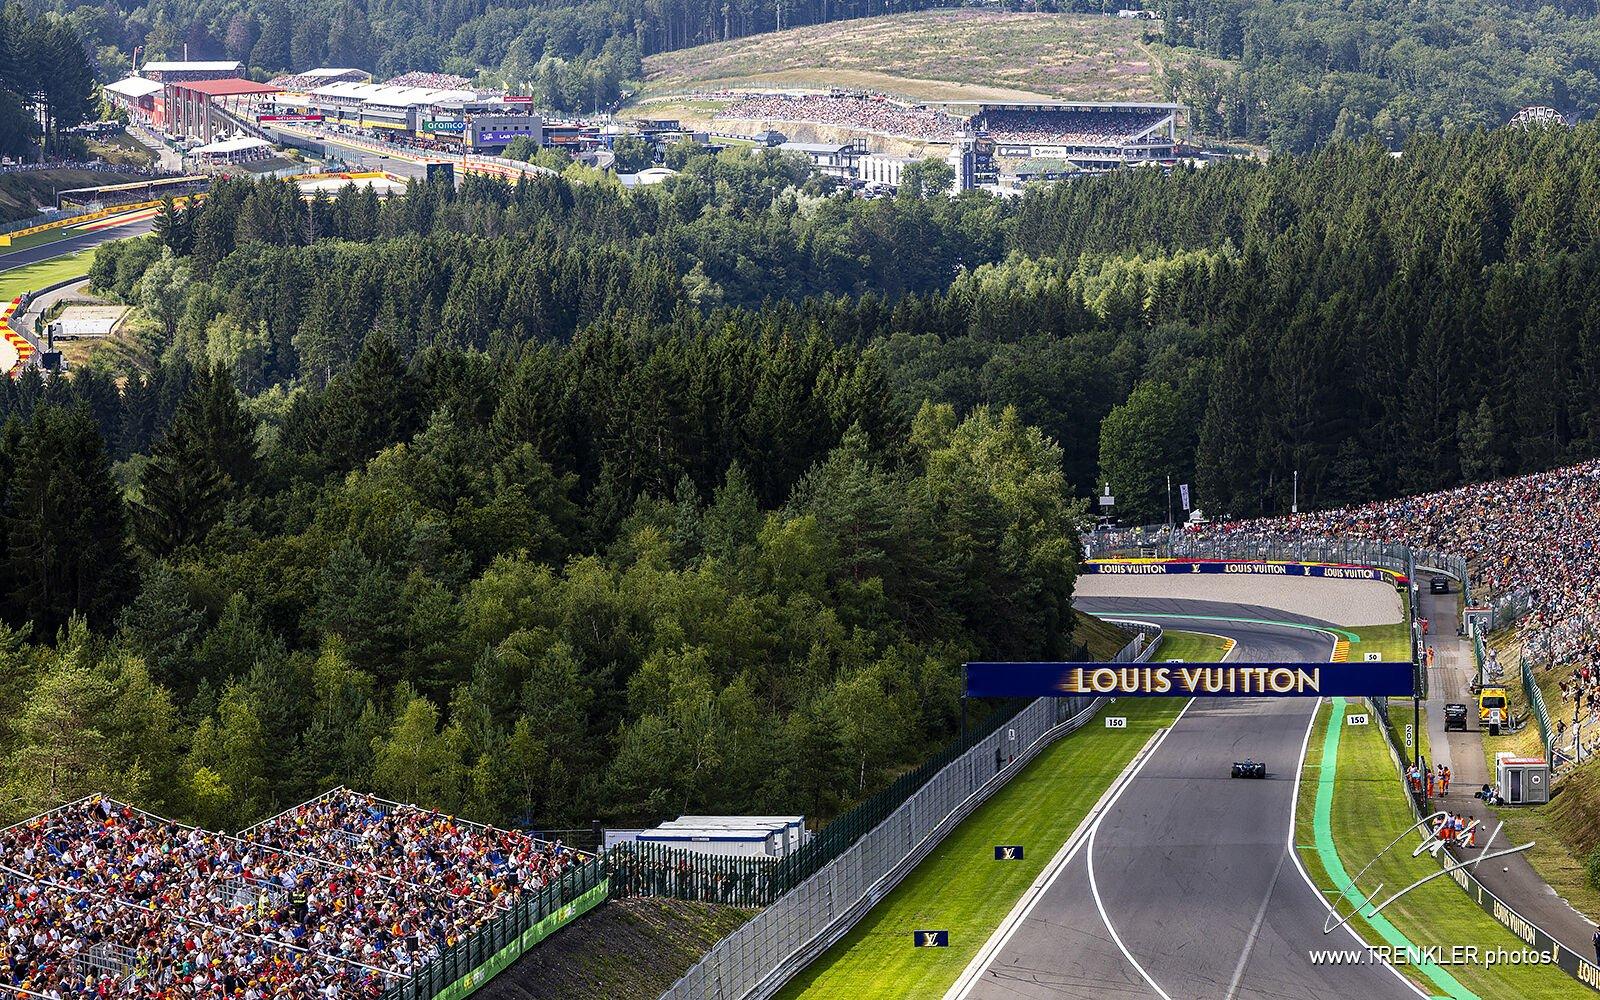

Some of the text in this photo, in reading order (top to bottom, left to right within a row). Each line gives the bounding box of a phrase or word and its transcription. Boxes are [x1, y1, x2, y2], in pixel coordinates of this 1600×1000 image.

[428, 121, 464, 129] aramco
[1099, 564, 1166, 574] LOUIS VUITTON
[1225, 564, 1286, 574] LOUIS VUITTON
[1324, 567, 1344, 578] LOUIS
[1344, 569, 1375, 579] VUITTON
[1076, 667, 1320, 693] LOUIS VUITTON
[1350, 716, 1365, 724] 150
[1493, 899, 1536, 946] LOUIS VUITTON
[1577, 960, 1600, 991] LOUI
